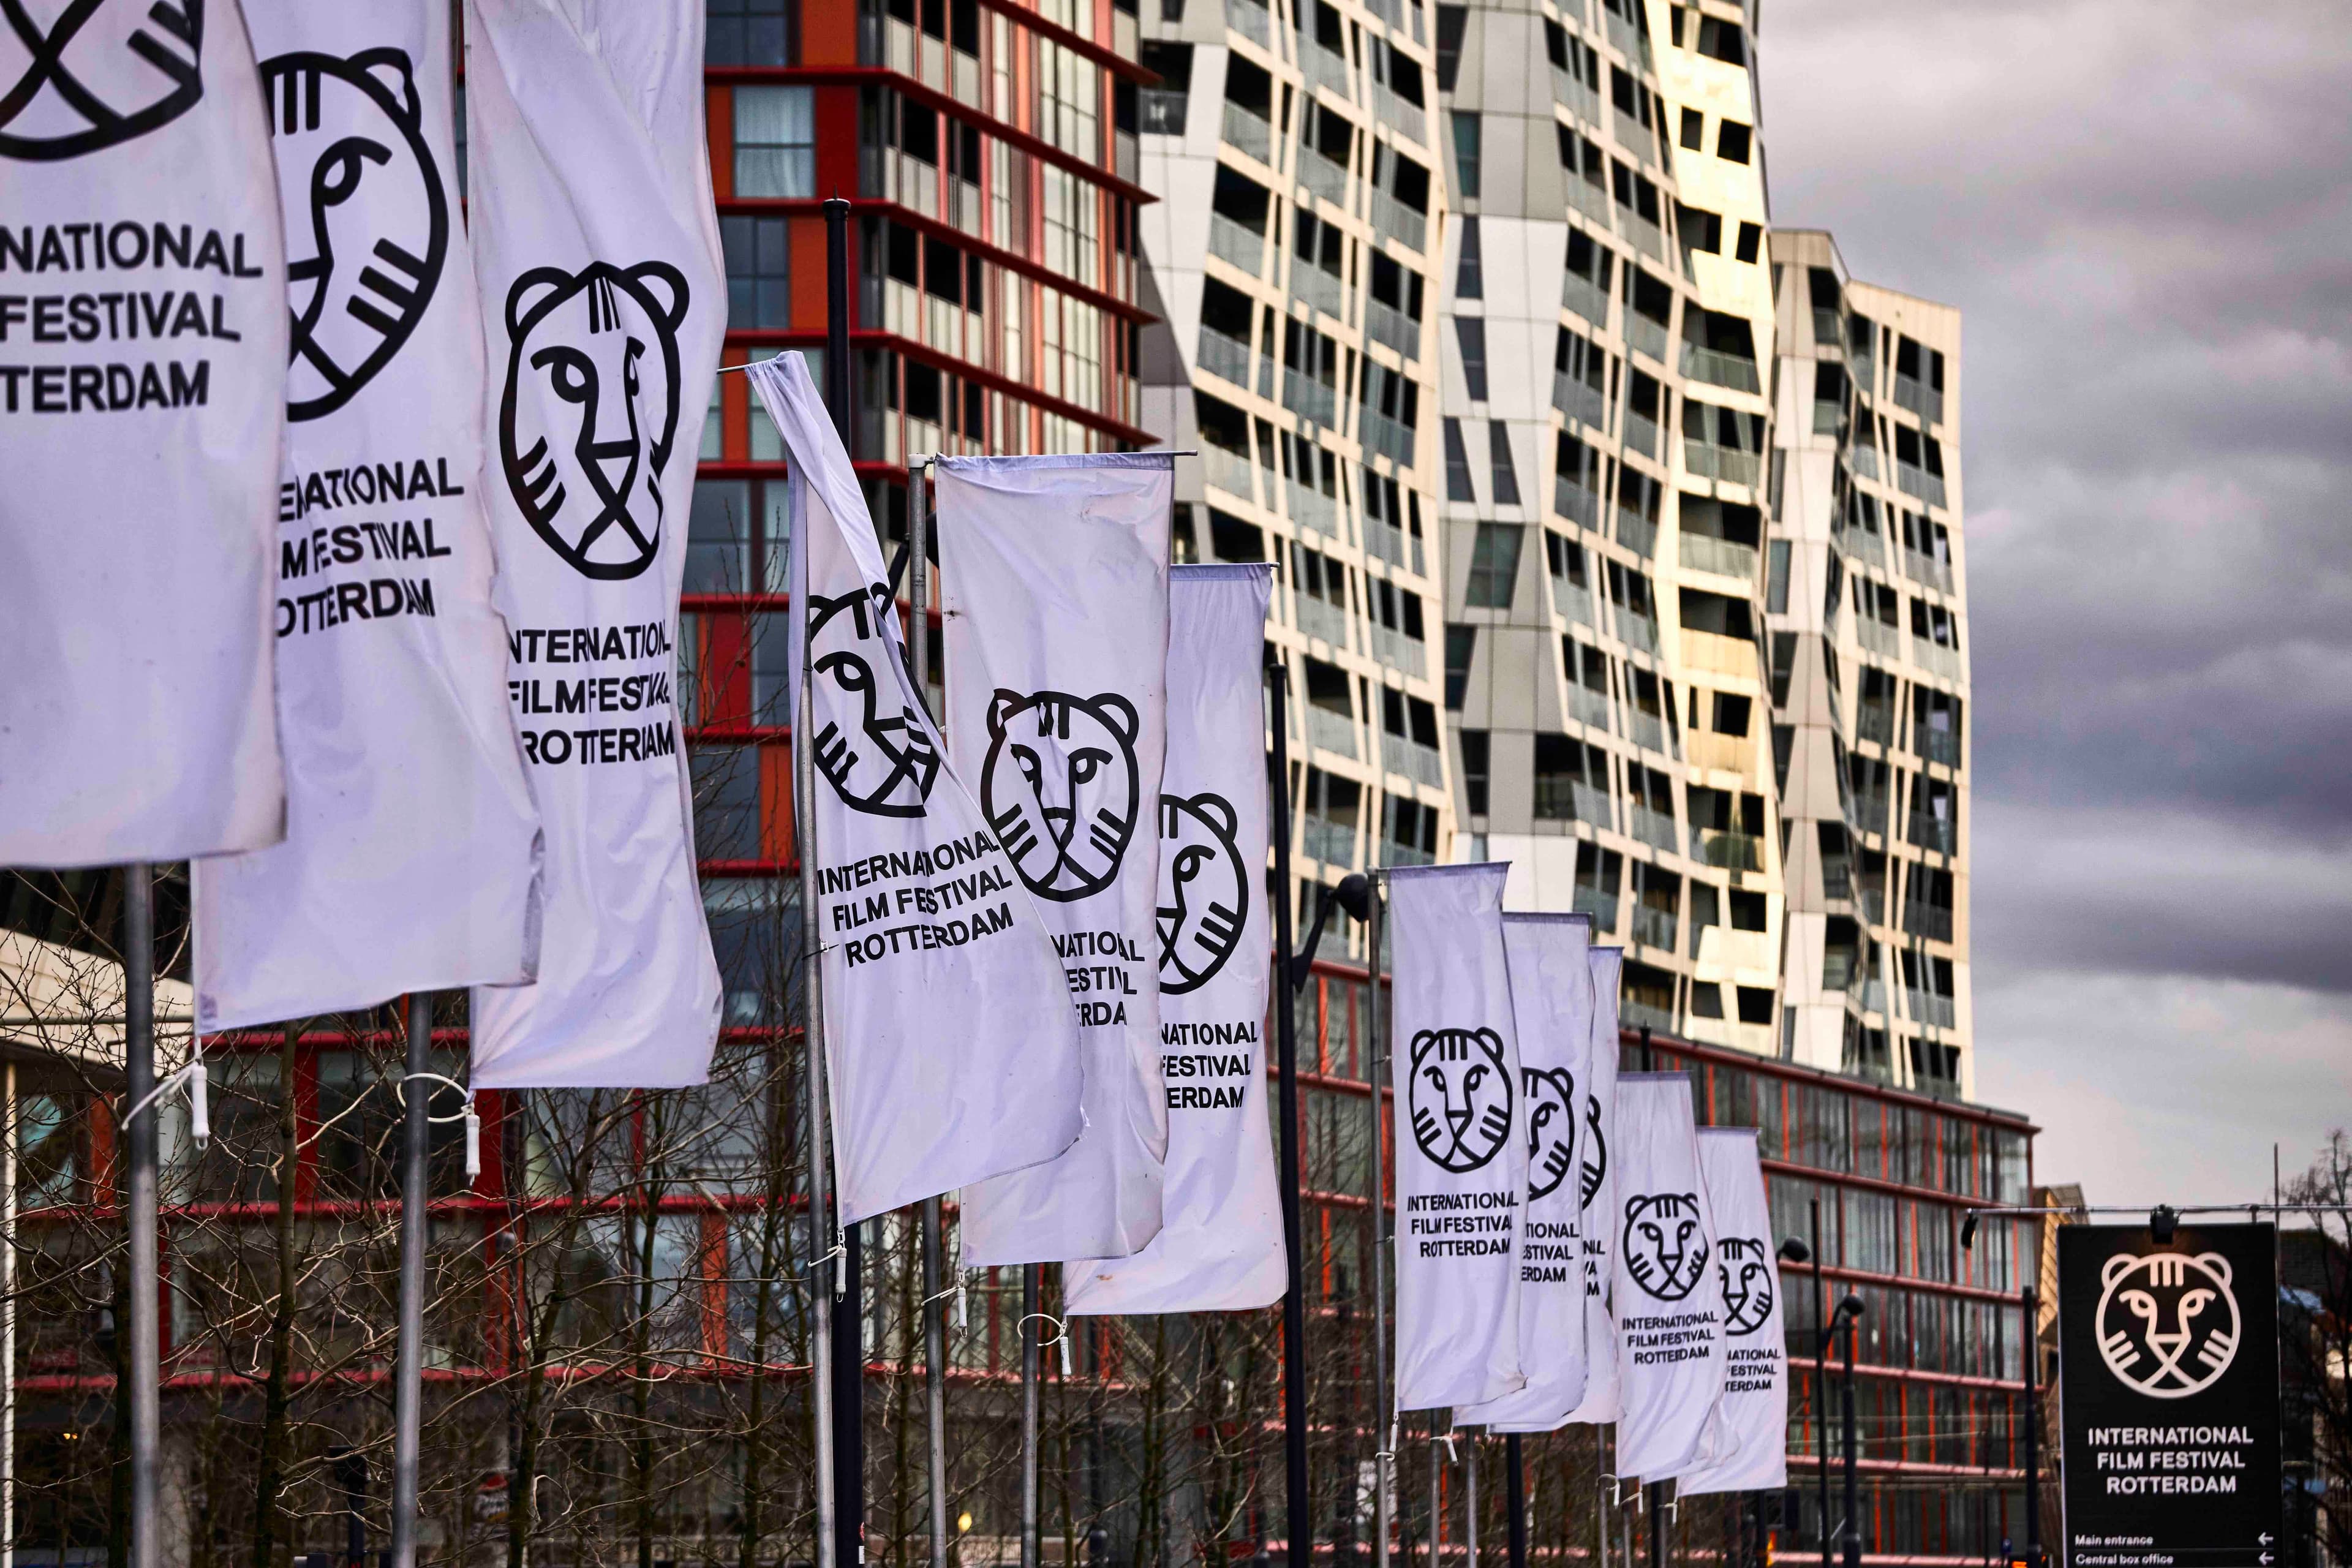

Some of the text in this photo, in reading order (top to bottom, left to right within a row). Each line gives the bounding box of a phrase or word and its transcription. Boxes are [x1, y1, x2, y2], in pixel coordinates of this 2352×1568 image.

[0, 221, 263, 278] NATIONAL
[0, 290, 241, 343] FESTIVAL
[0, 360, 210, 413] TERDAM
[832, 864, 1013, 932] FILM FESTIVAL
[845, 902, 1014, 968] ROTTERDAM
[1166, 1086, 1245, 1109] ERDAM
[1420, 1237, 1510, 1257] ROTTERDAM
[1622, 1311, 1719, 1331] INTERNATIONAL
[1627, 1334, 1659, 1348] FILM
[2088, 1426, 2254, 1446] INTERNATIONAL
[2097, 1451, 2245, 1469] FILM FESTIVAL
[2106, 1476, 2236, 1494] ROTTERDAM
[2075, 1534, 2154, 1545] Main entrance
[2075, 1553, 2174, 1564] Central box office
